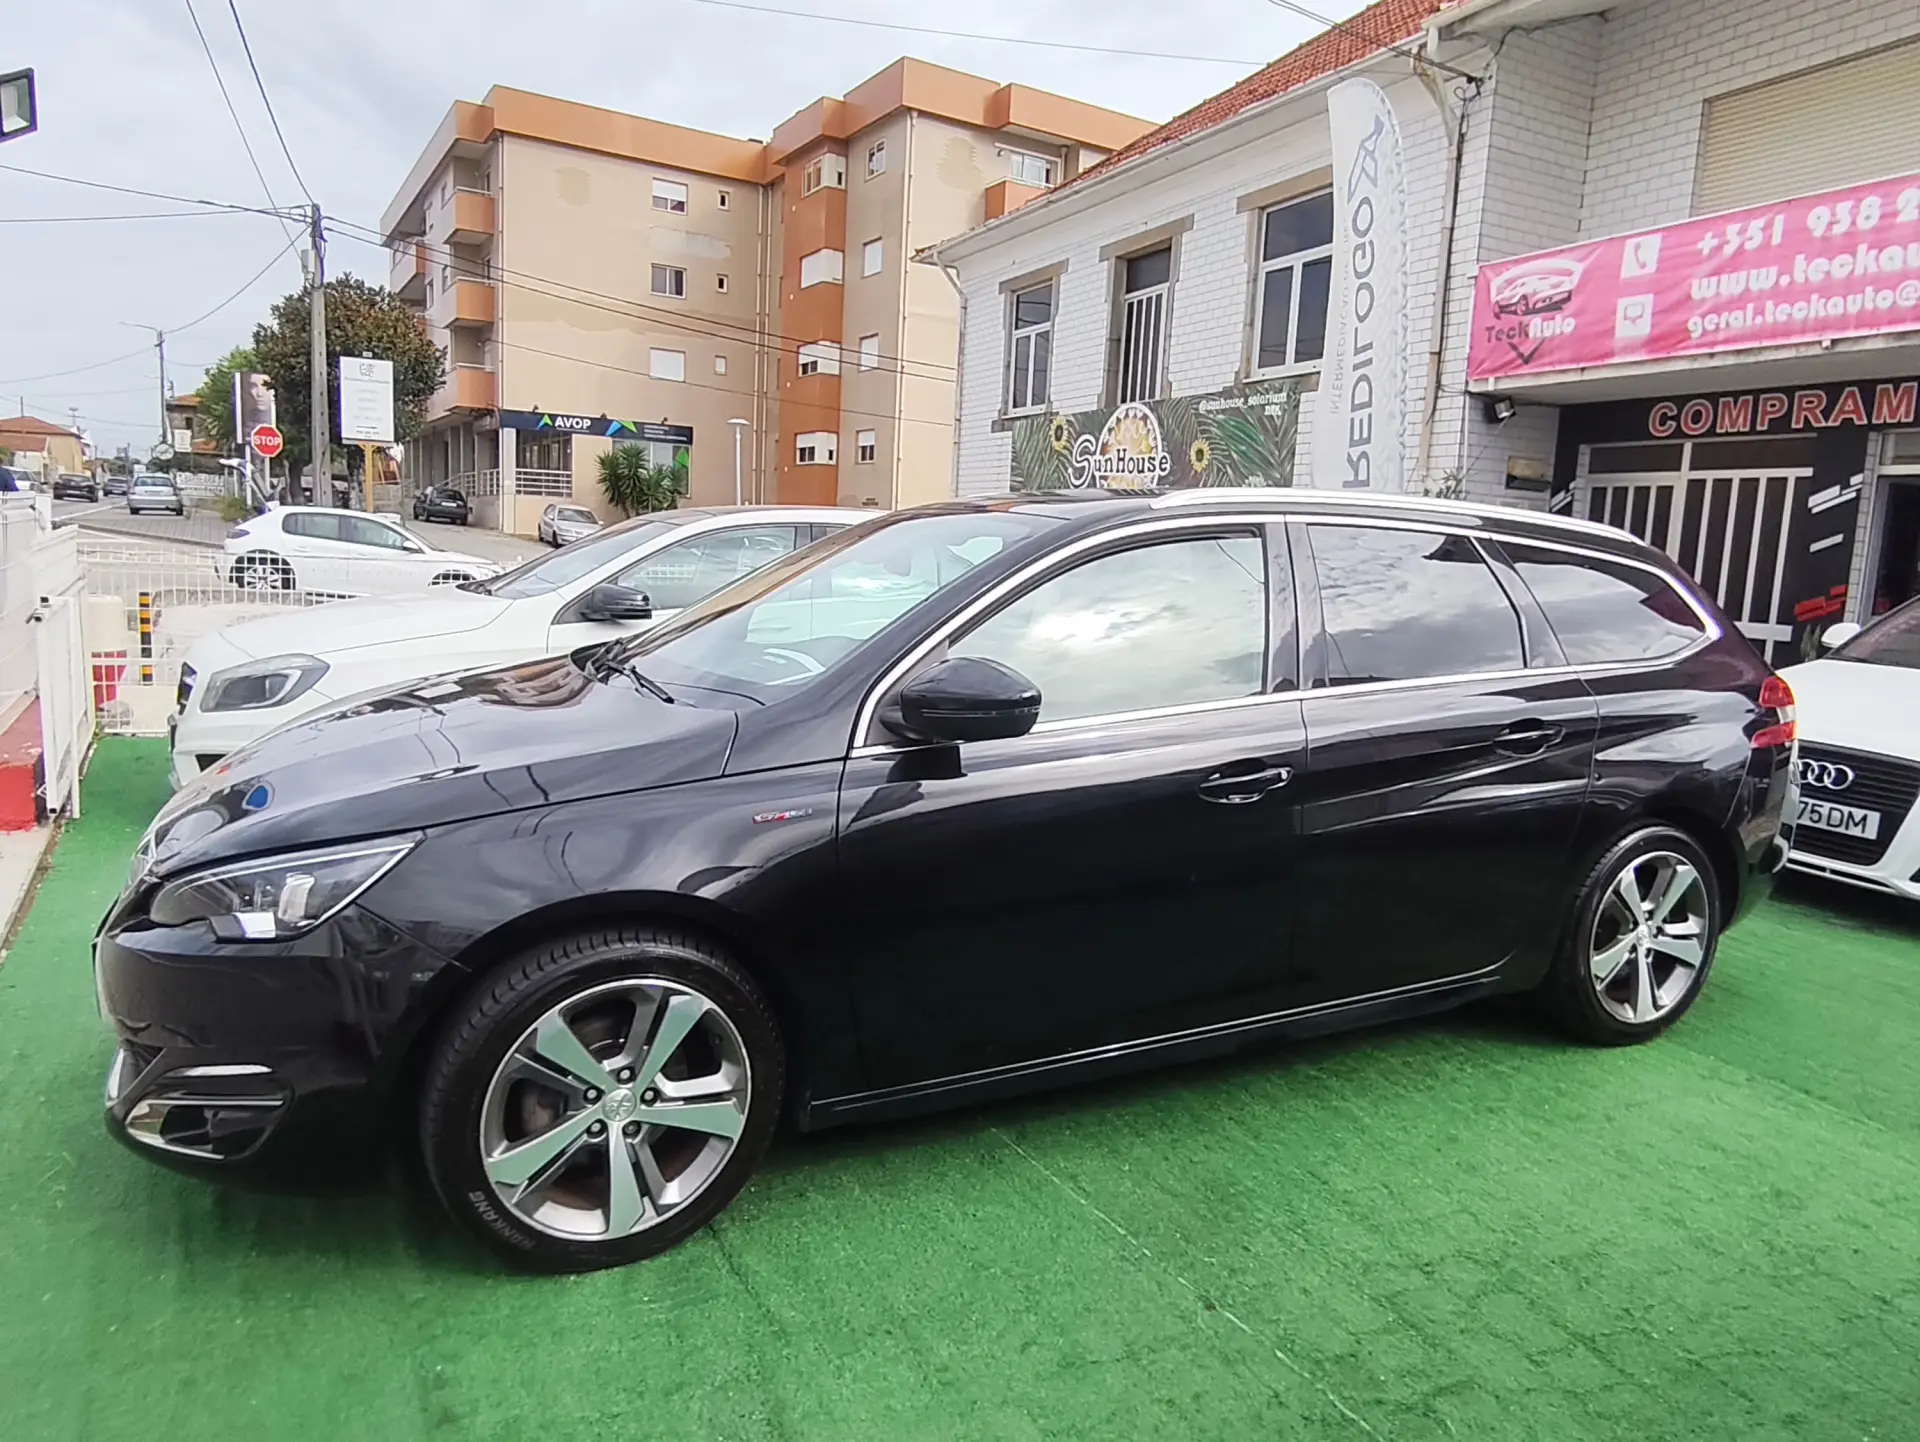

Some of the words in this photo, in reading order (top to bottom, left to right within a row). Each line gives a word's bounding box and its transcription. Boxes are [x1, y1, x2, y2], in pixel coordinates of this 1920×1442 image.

[1697, 213, 1785, 258] +351
[1806, 195, 1883, 238] 938
[253, 435, 281, 446] STOP
[554, 415, 591, 430] AVOP
[1067, 434, 1171, 489] SunHouse
[468, 1190, 537, 1250] NANKANG
